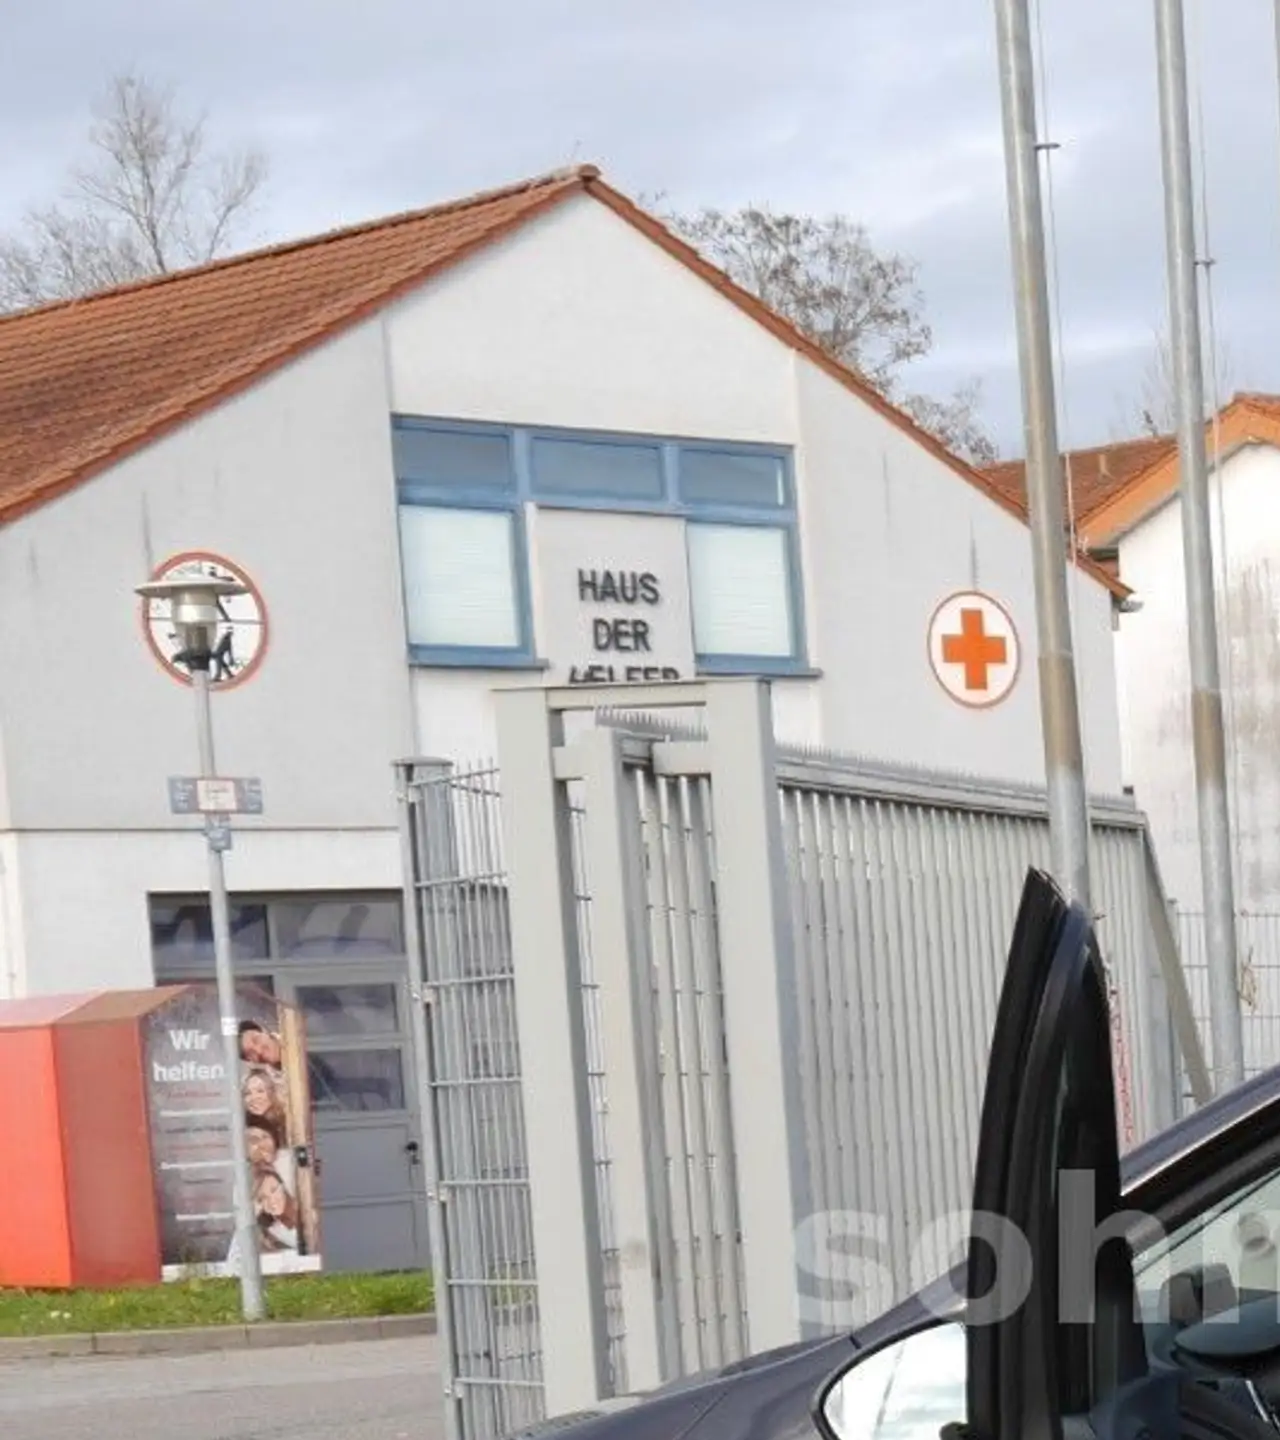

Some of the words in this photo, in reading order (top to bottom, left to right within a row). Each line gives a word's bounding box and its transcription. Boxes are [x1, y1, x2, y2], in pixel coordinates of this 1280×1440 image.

[578, 568, 660, 605] HAUS
[593, 618, 652, 651] DER
[168, 1027, 211, 1051] Wir
[152, 1061, 225, 1082] helfen
